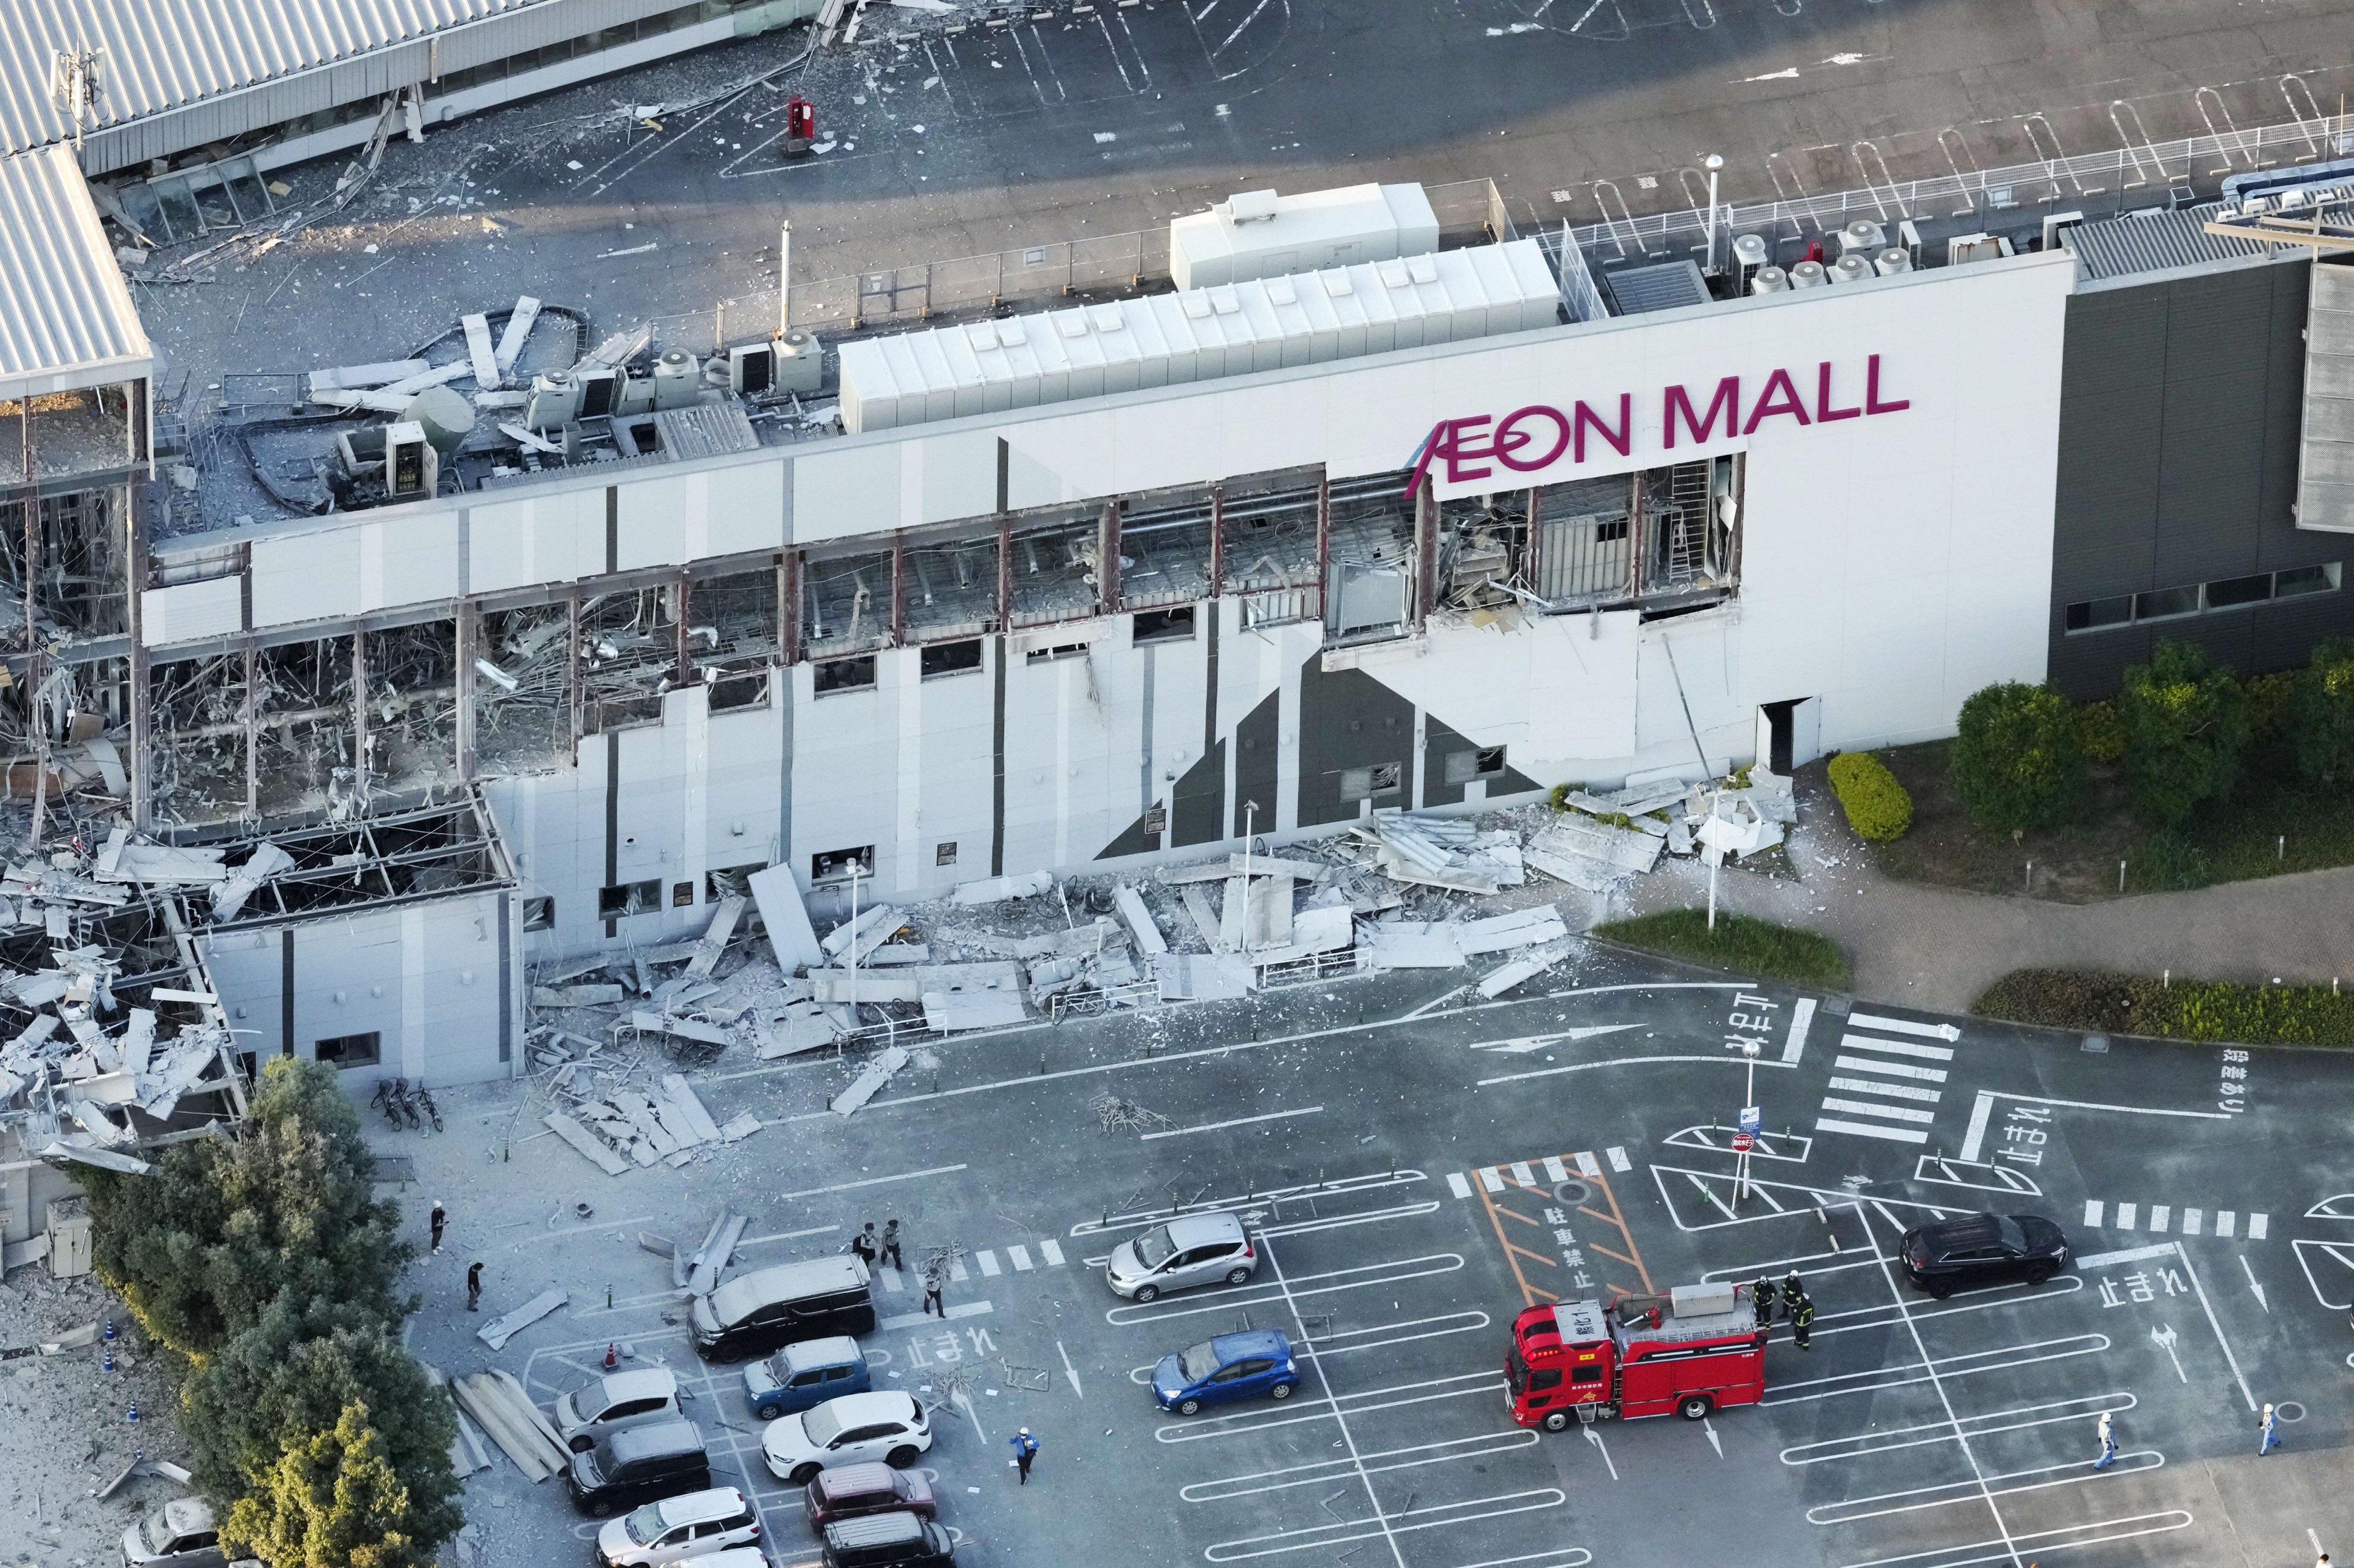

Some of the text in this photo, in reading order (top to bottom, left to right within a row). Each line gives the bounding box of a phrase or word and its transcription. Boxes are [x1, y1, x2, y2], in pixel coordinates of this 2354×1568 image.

[1664, 354, 1910, 449] MALL
[2218, 1049, 2249, 1112] 段差あり
[1997, 1107, 2052, 1166] 止まれ
[1544, 1207, 1595, 1288] 駐車禁止
[2098, 1267, 2188, 1308] 止まれ
[907, 1327, 998, 1368] 止まれ
